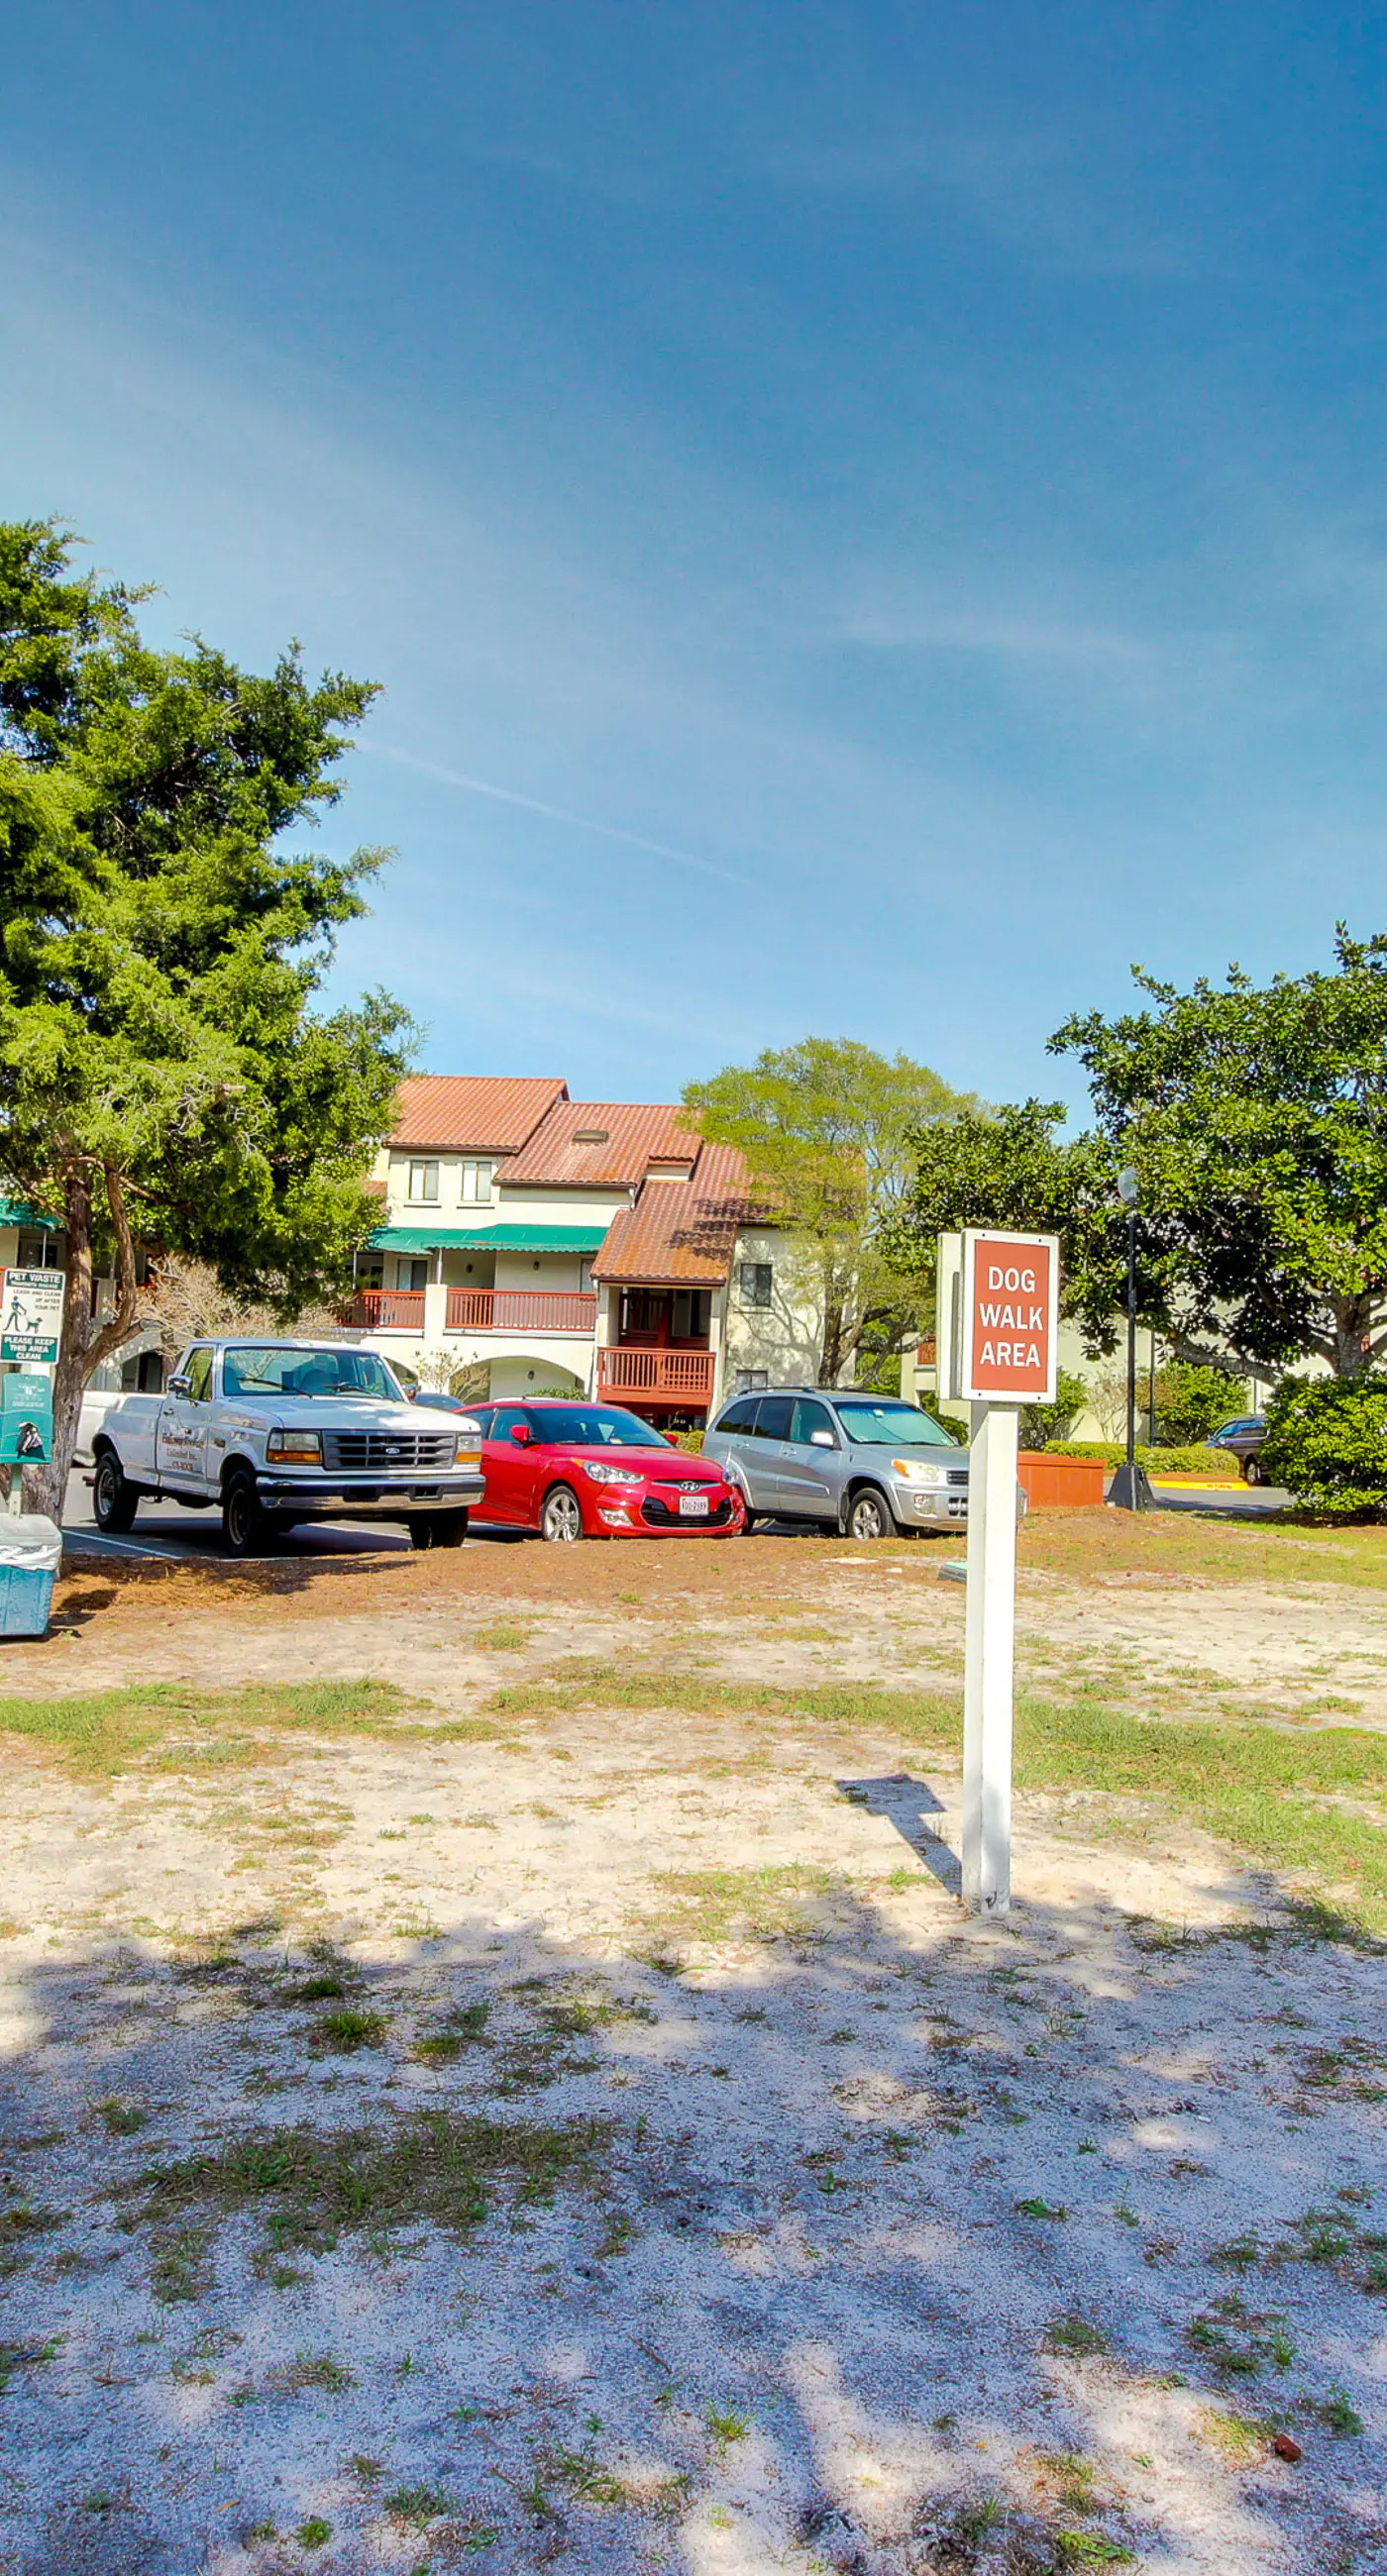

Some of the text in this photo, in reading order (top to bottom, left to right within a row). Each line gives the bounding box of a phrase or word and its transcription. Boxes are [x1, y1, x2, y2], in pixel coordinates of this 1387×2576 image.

[9, 1272, 61, 1284] PET WASTE
[988, 1266, 1036, 1293] DOG
[979, 1302, 1043, 1331] WALK
[4, 1336, 33, 1345] PLEASE
[16, 1352, 42, 1361] CLEAN
[979, 1341, 1041, 1368] AREA
